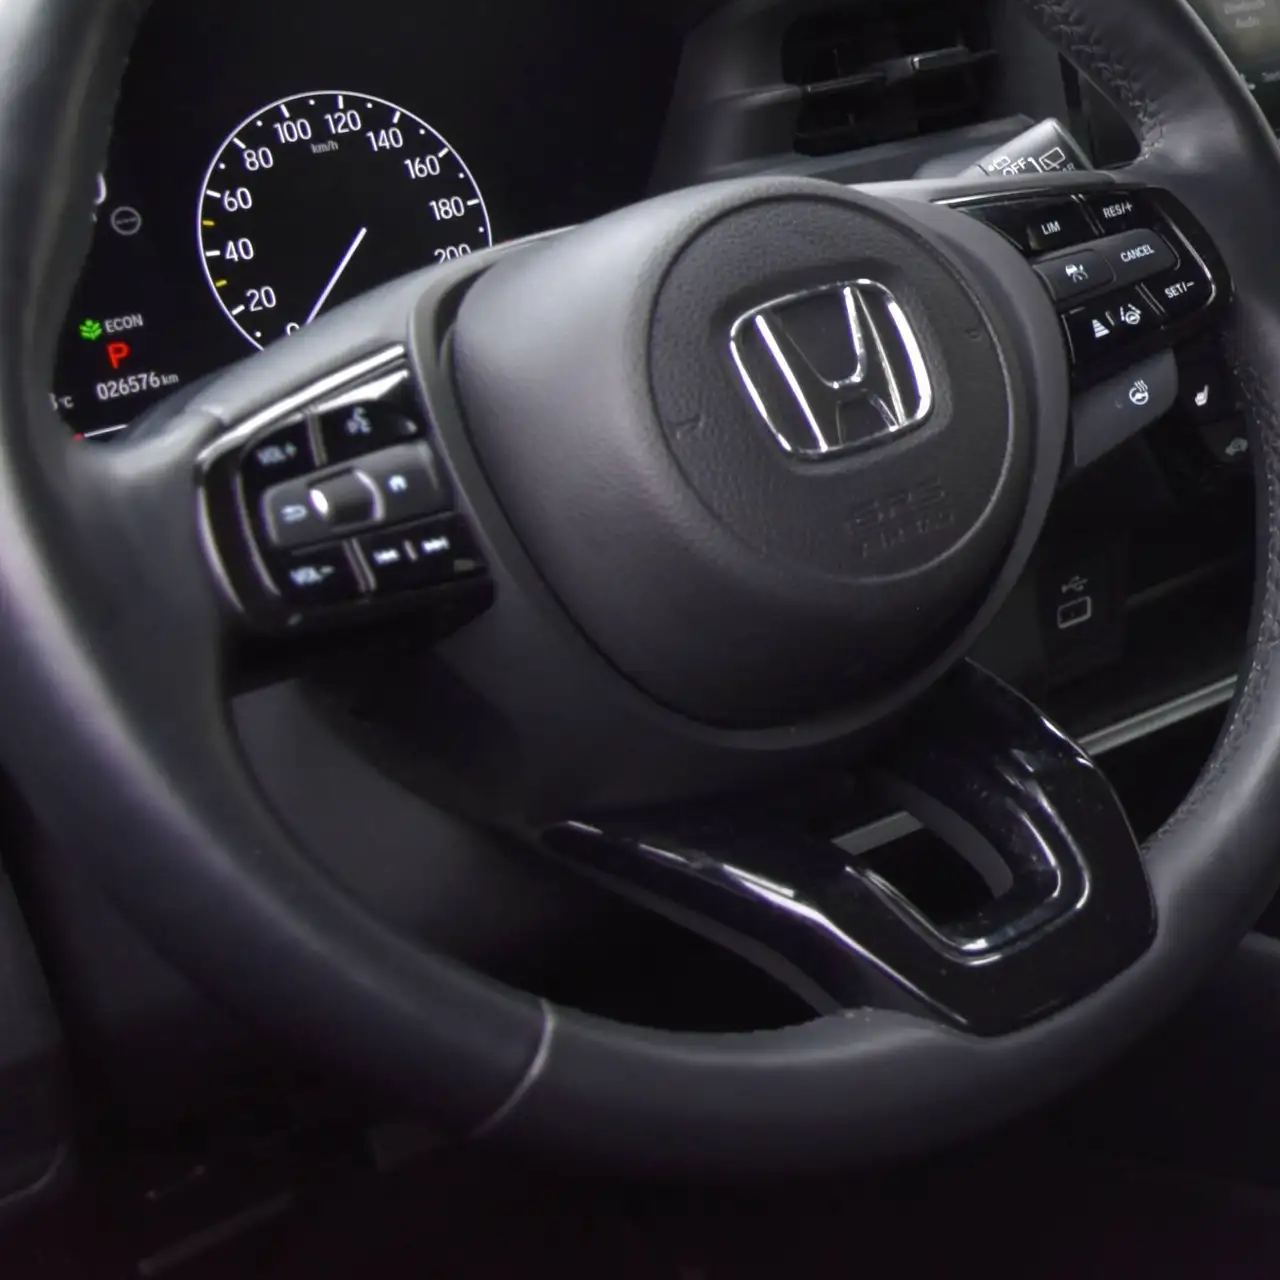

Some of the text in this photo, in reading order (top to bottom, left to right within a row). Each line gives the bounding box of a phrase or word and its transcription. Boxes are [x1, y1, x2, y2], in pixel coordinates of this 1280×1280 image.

[273, 118, 313, 145] 100
[324, 109, 362, 136] 120
[310, 139, 340, 155] km/h
[366, 126, 404, 153] 140
[243, 146, 275, 172] 80
[404, 154, 441, 180] 160
[223, 187, 253, 212] 60
[428, 195, 466, 222] 180
[1103, 200, 1133, 219] RES/+
[1041, 221, 1061, 236] LIM
[224, 237, 255, 262] 40
[1120, 244, 1155, 263] CANCEL
[246, 284, 277, 312] 20
[104, 314, 143, 333] ECON
[107, 341, 130, 369] P
[96, 372, 179, 401] 026576 km
